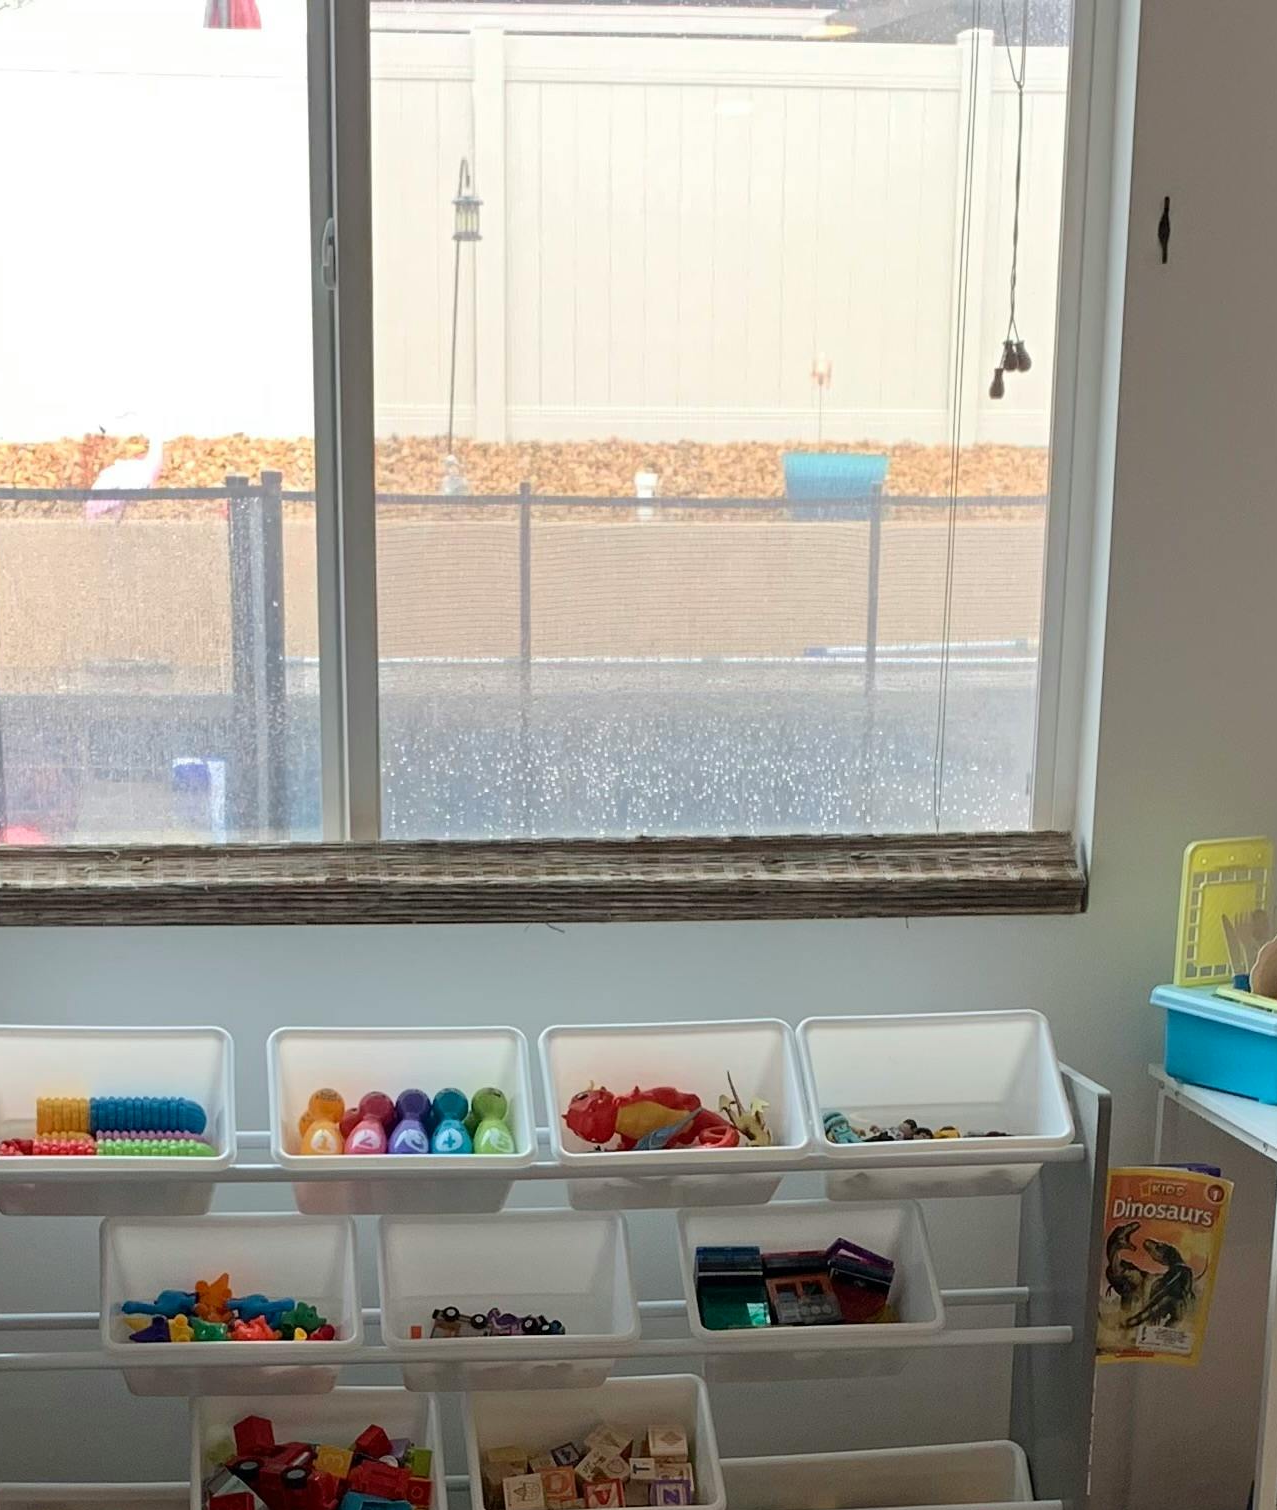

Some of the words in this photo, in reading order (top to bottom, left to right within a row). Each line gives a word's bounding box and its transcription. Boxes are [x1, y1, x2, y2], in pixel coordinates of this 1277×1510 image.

[1151, 1183, 1187, 1197] KIDS
[1212, 1189, 1220, 1201] 1
[1112, 1197, 1214, 1227] Dinosaurs
